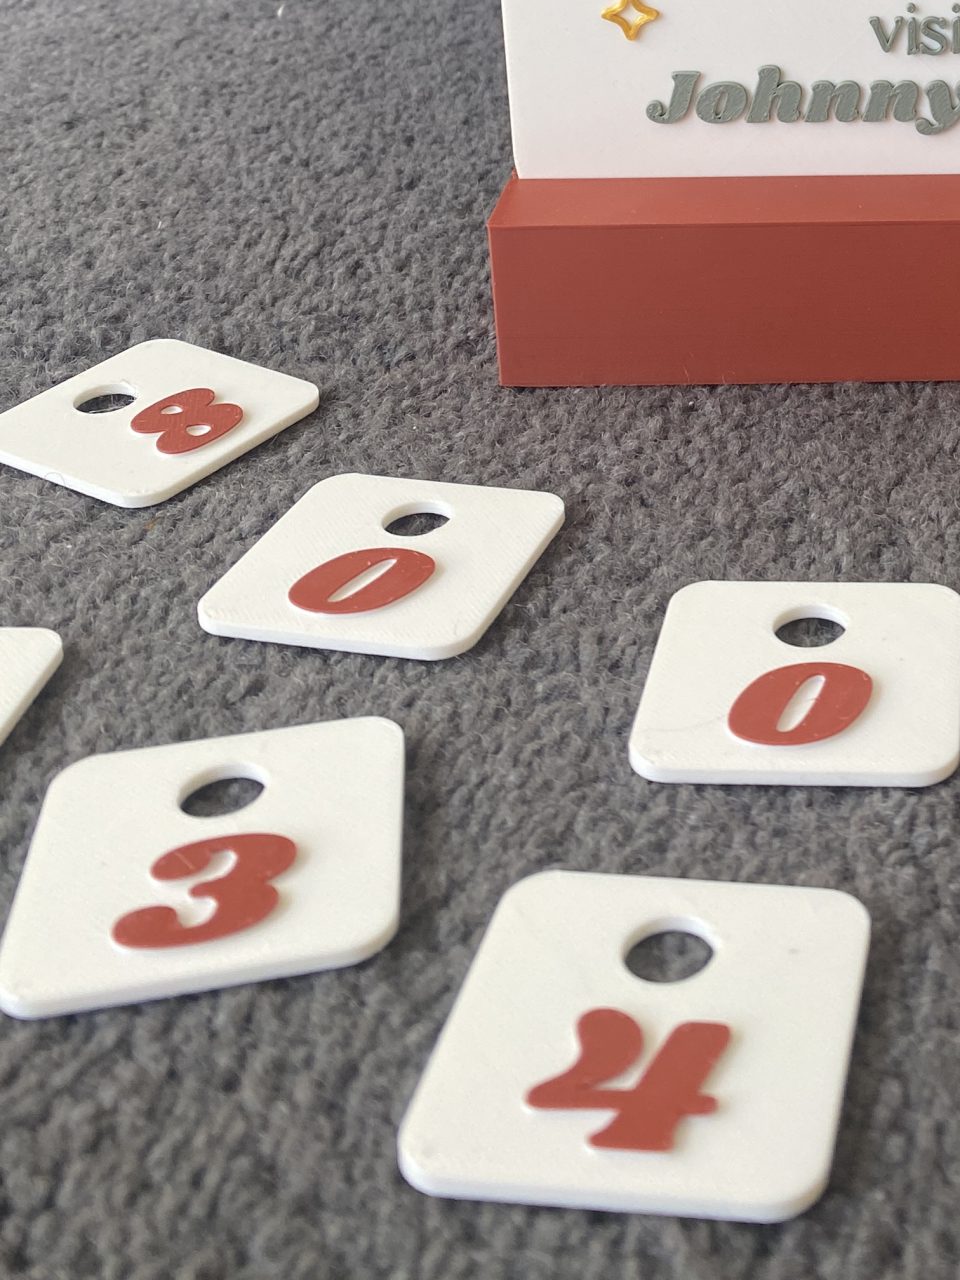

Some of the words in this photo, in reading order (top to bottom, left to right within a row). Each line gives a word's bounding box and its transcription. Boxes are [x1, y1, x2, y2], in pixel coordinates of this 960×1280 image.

[131, 388, 244, 455] 8
[288, 547, 436, 614] 0
[728, 662, 873, 746] 0
[113, 833, 298, 948] 3
[527, 1008, 732, 1152] 4
